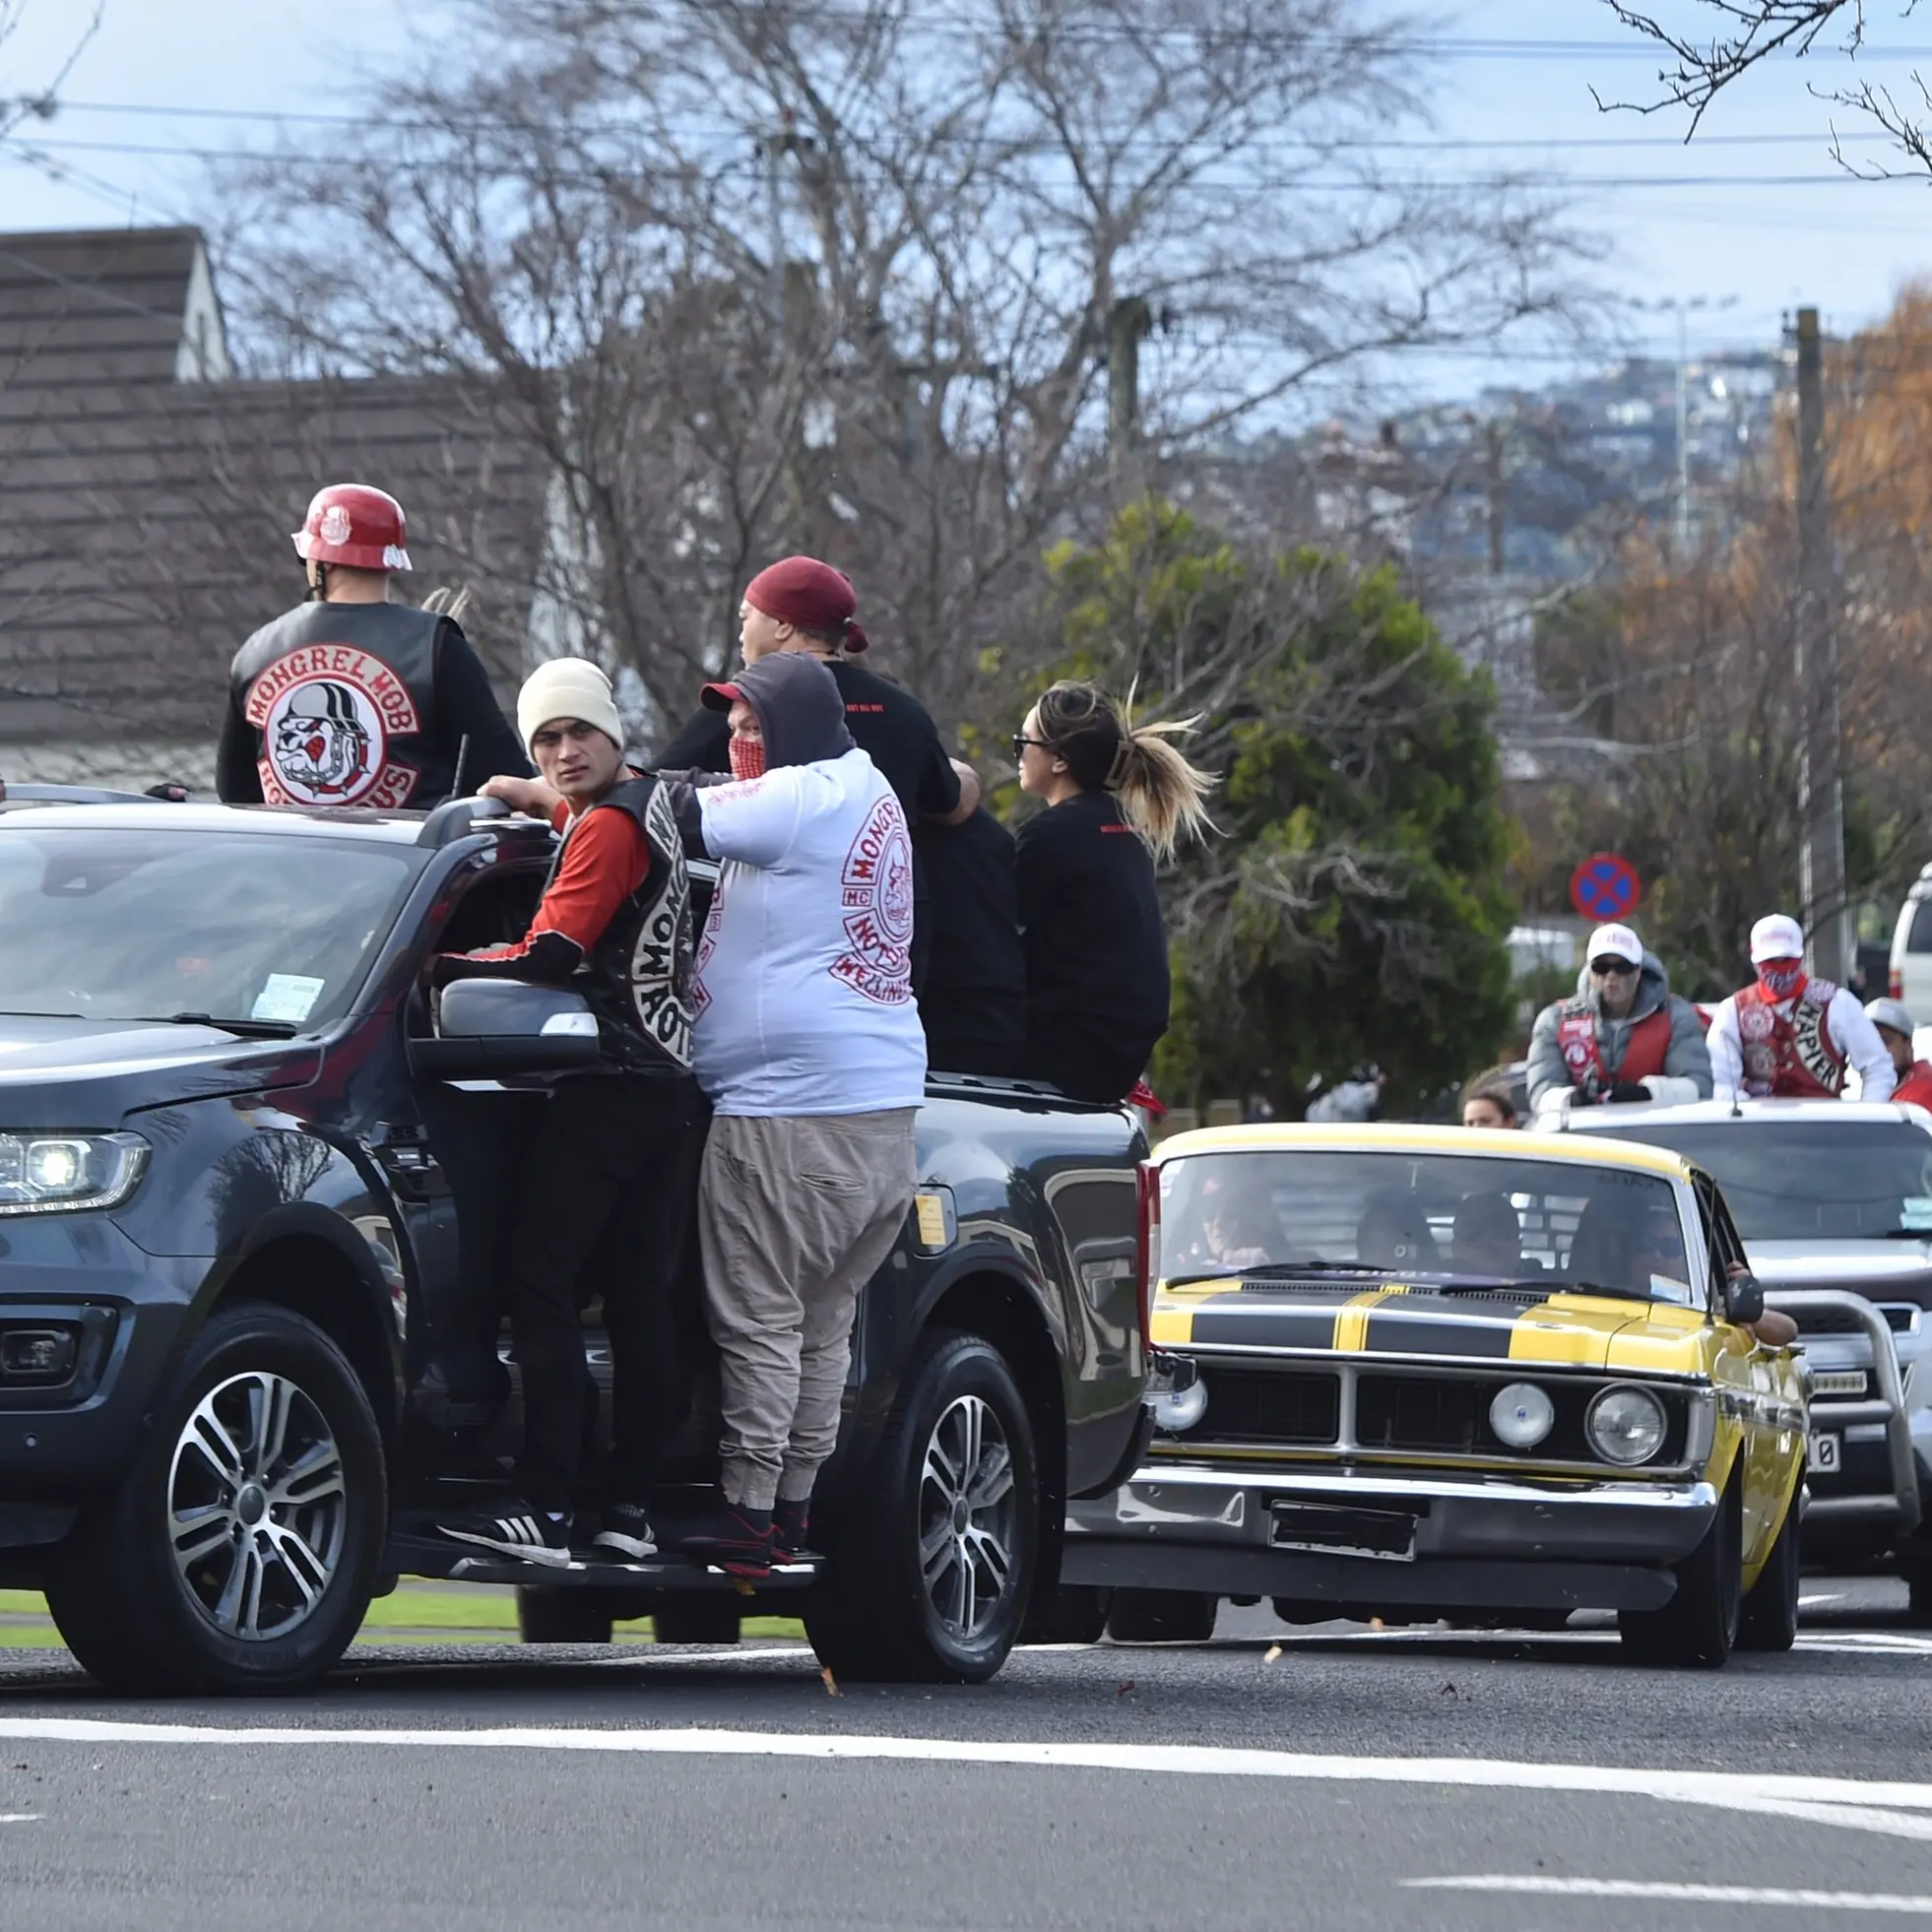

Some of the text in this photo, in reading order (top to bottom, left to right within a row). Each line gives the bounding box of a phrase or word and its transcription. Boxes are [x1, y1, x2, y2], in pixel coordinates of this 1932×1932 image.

[250, 647, 414, 730] MONGREL MOB
[847, 890, 869, 905] MC
[1798, 1001, 1836, 1086] NAPIER
